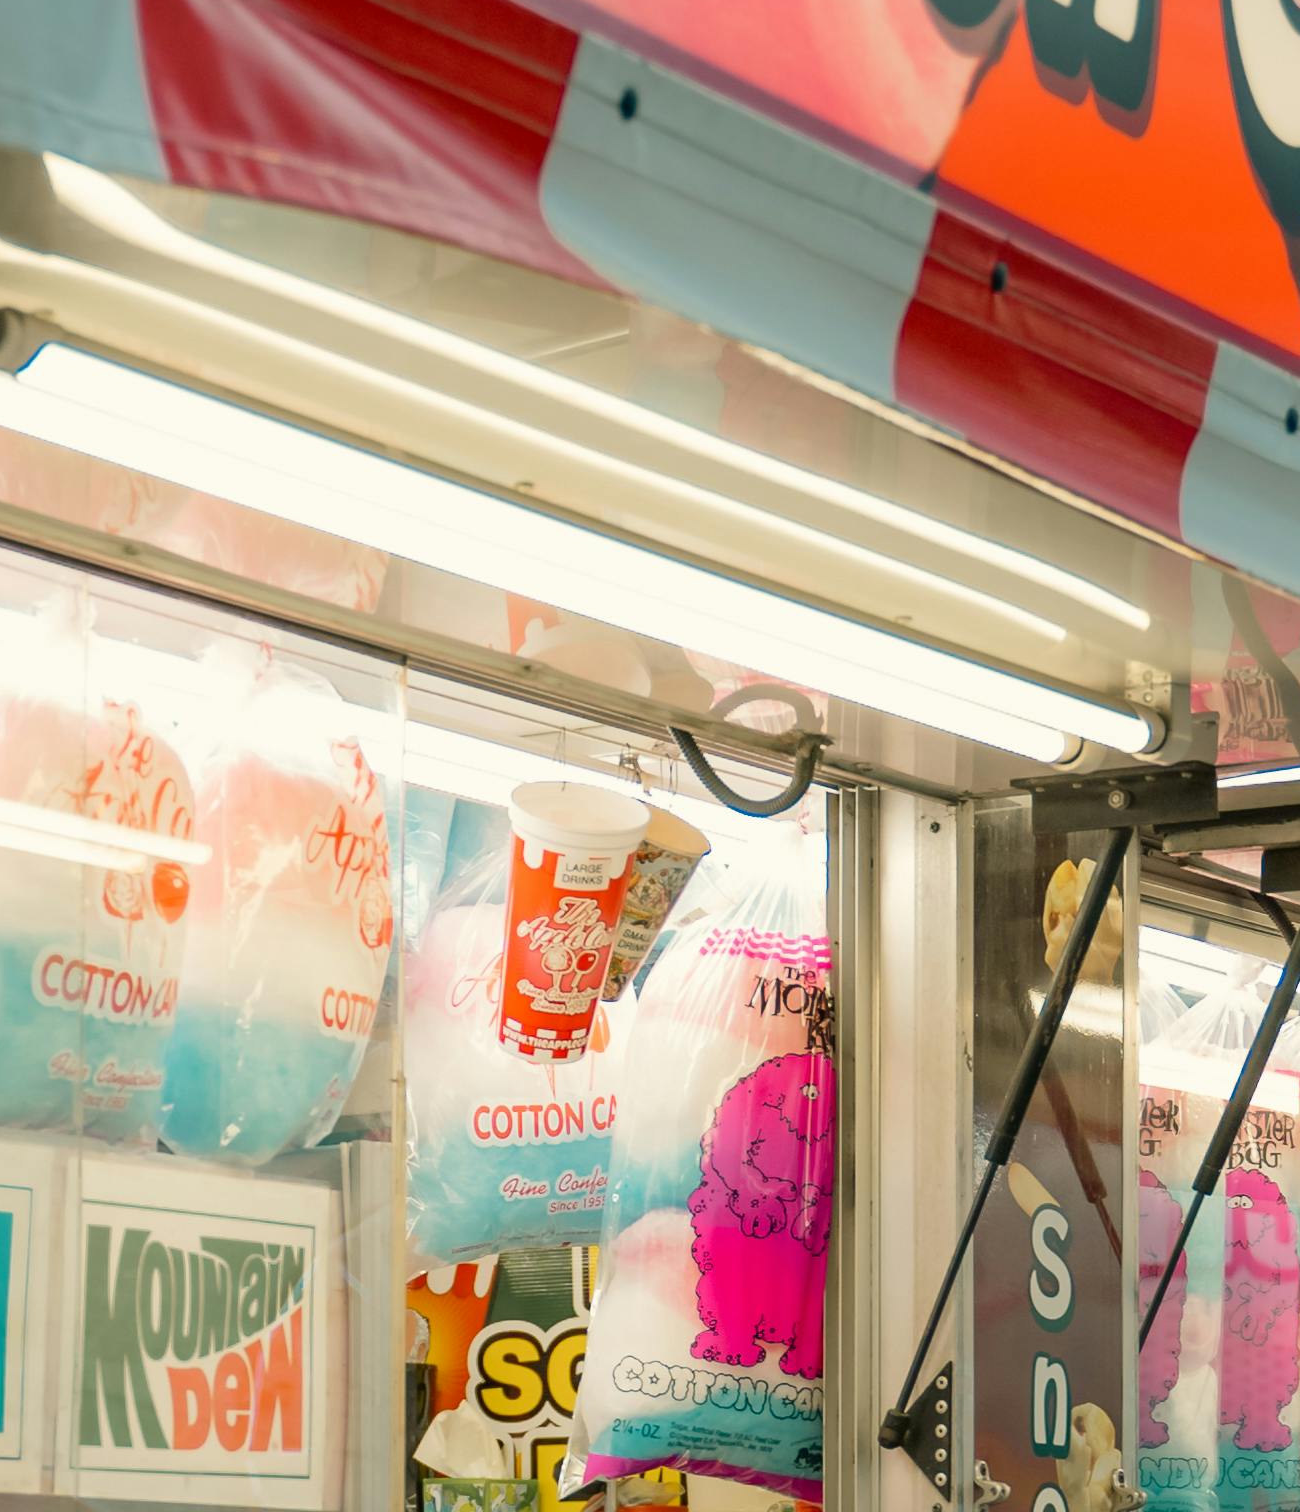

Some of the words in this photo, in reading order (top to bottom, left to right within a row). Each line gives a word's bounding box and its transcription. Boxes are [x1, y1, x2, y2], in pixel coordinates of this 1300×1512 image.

[561, 871, 604, 885] DRINKS
[565, 863, 603, 874] LARGE
[40, 954, 152, 1018] COTTON
[473, 1101, 584, 1140] COTTON
[503, 1177, 547, 1199] Fine
[549, 1202, 578, 1214] Since
[612, 1355, 769, 1415] COTTON
